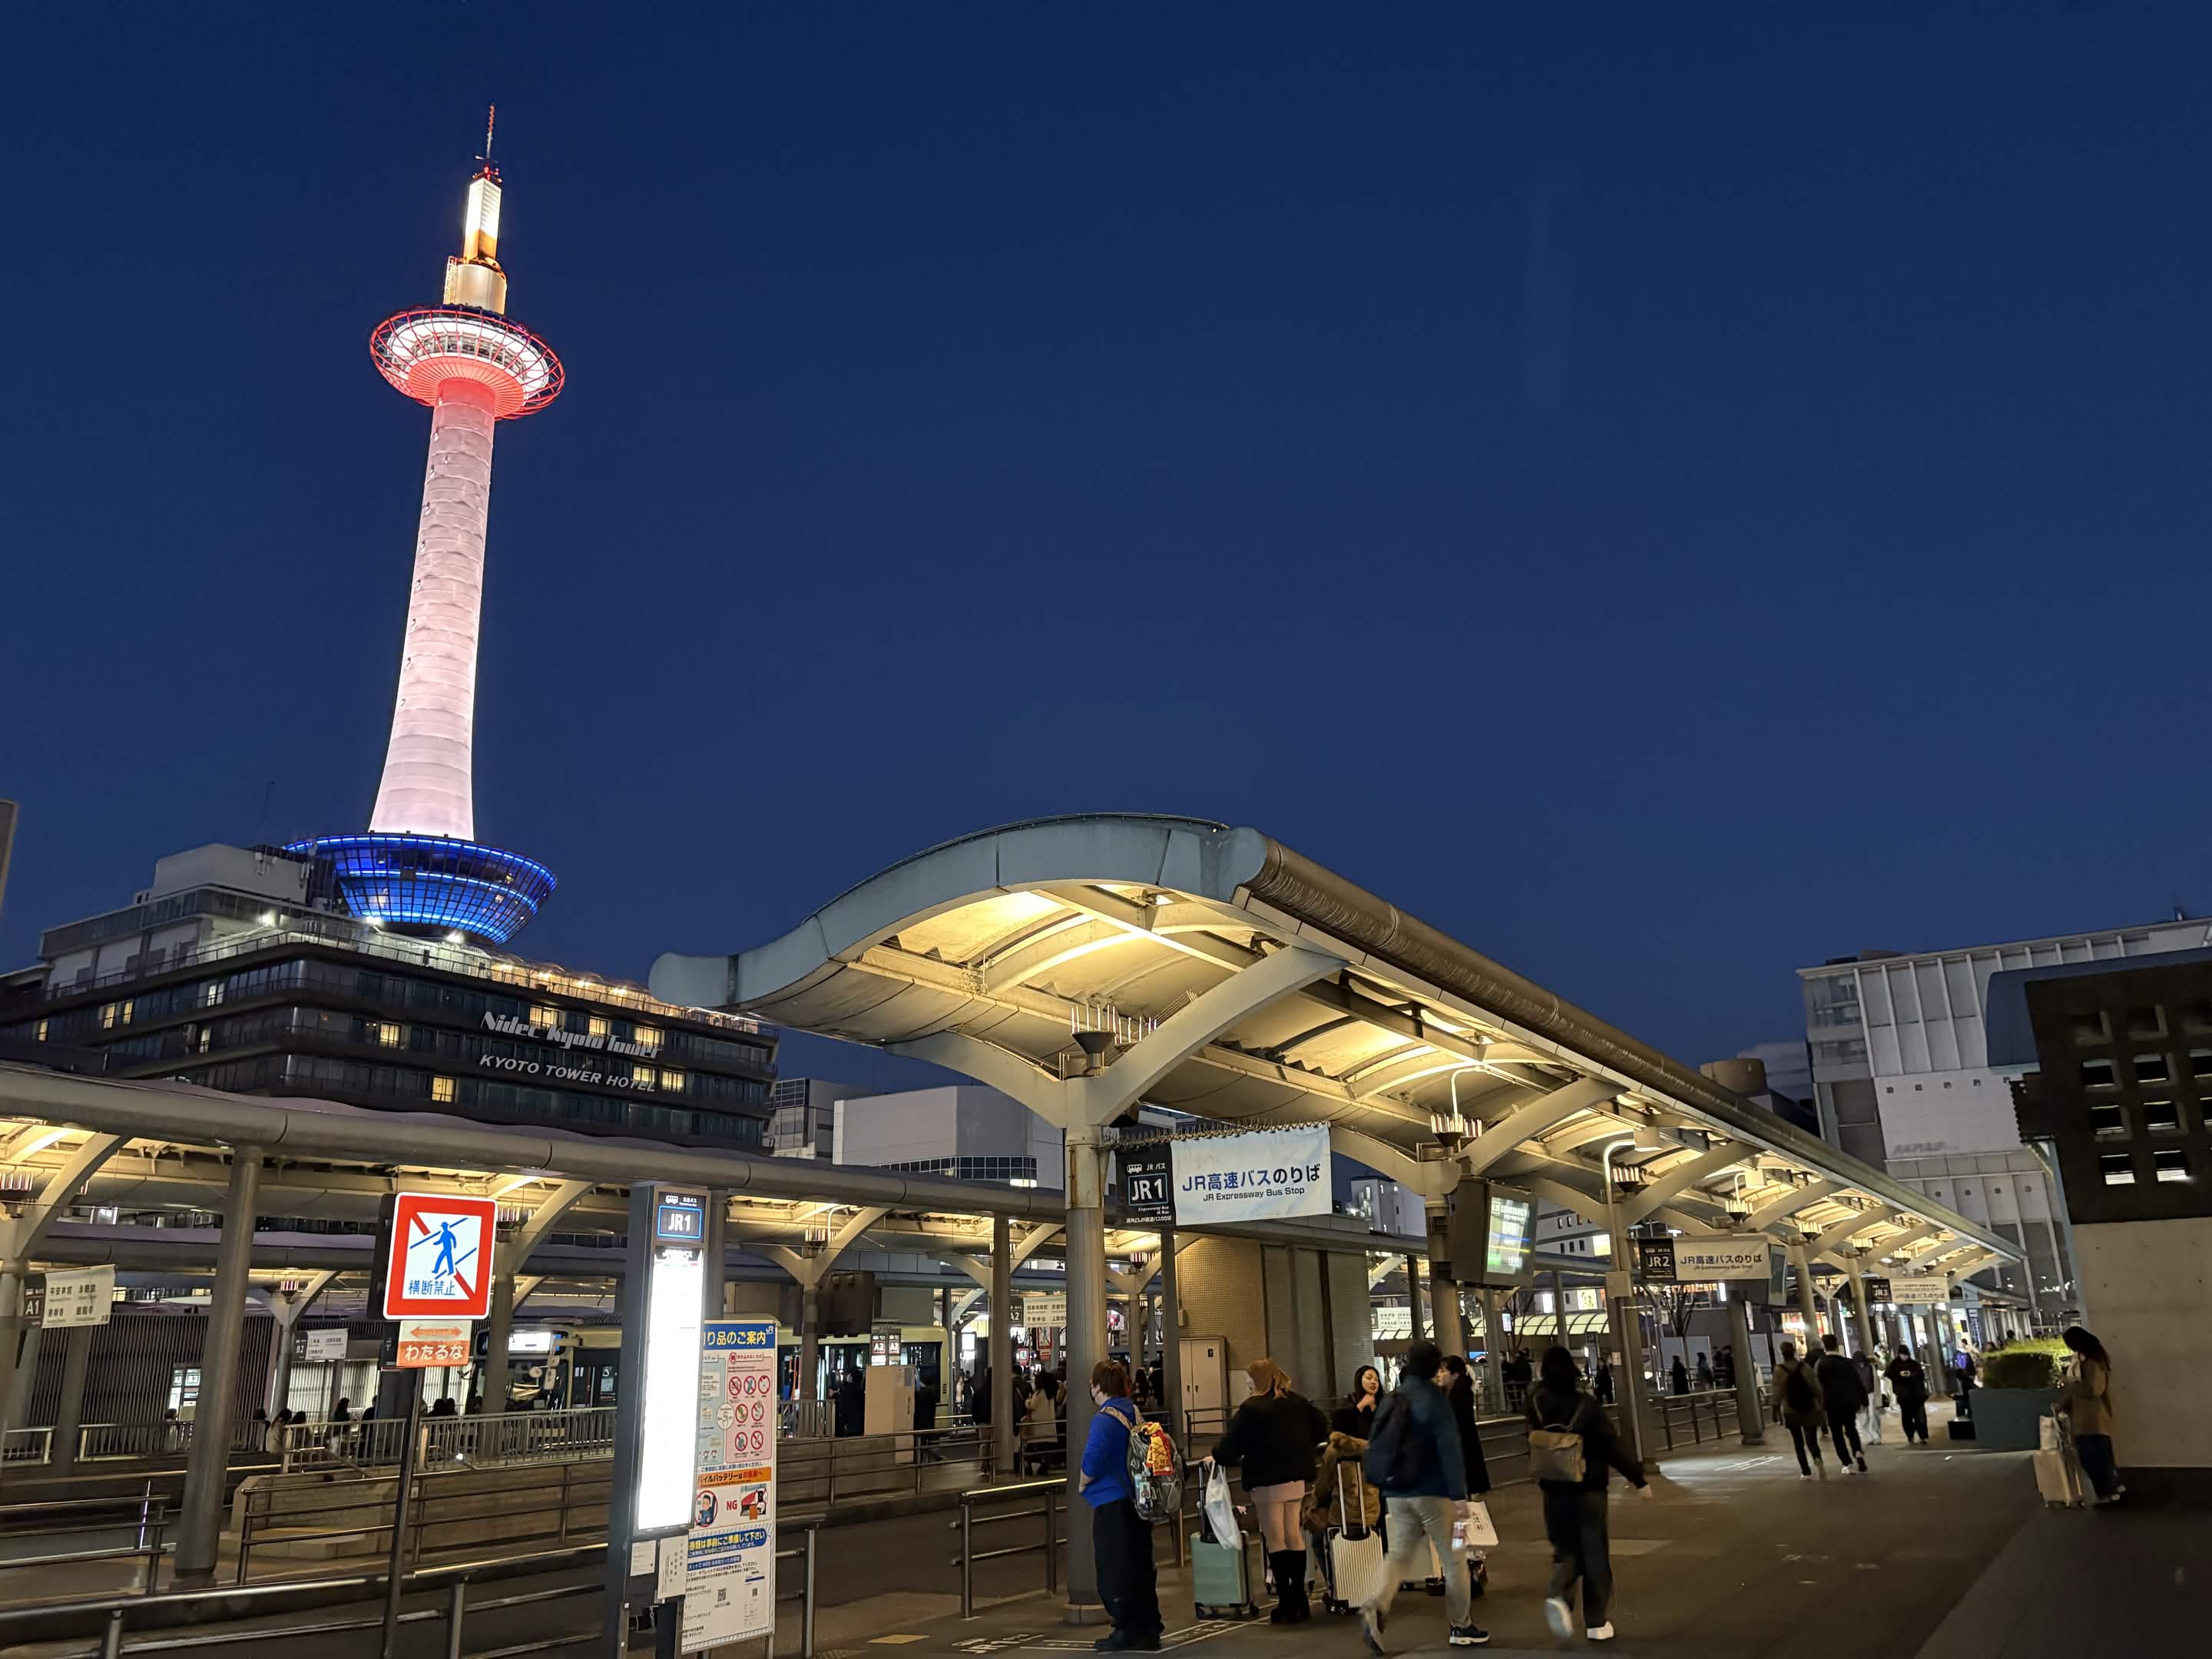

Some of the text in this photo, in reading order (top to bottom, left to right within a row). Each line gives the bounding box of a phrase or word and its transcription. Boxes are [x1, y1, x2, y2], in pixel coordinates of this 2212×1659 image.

[480, 1011, 663, 1058] Nidec Kyoto Tower
[479, 1054, 655, 1092] KYOTO TOWER HOTEL
[1182, 1163, 1320, 1191] JR高速バスのりば
[1203, 1193, 1214, 1201] JR
[1216, 1190, 1263, 1200] Expressway
[1285, 1187, 1305, 1196] Stop
[668, 1214, 690, 1231] JR1
[1647, 1256, 1671, 1267] JR2
[1681, 1253, 1763, 1264] JR高速バスのりば
[408, 1280, 455, 1296] 横断禁止
[25, 1300, 39, 1316] A1
[703, 1331, 766, 1346] り品のご案内
[405, 1345, 463, 1361] わたるな
[873, 1343, 884, 1351] A2
[727, 1500, 737, 1511] NG
